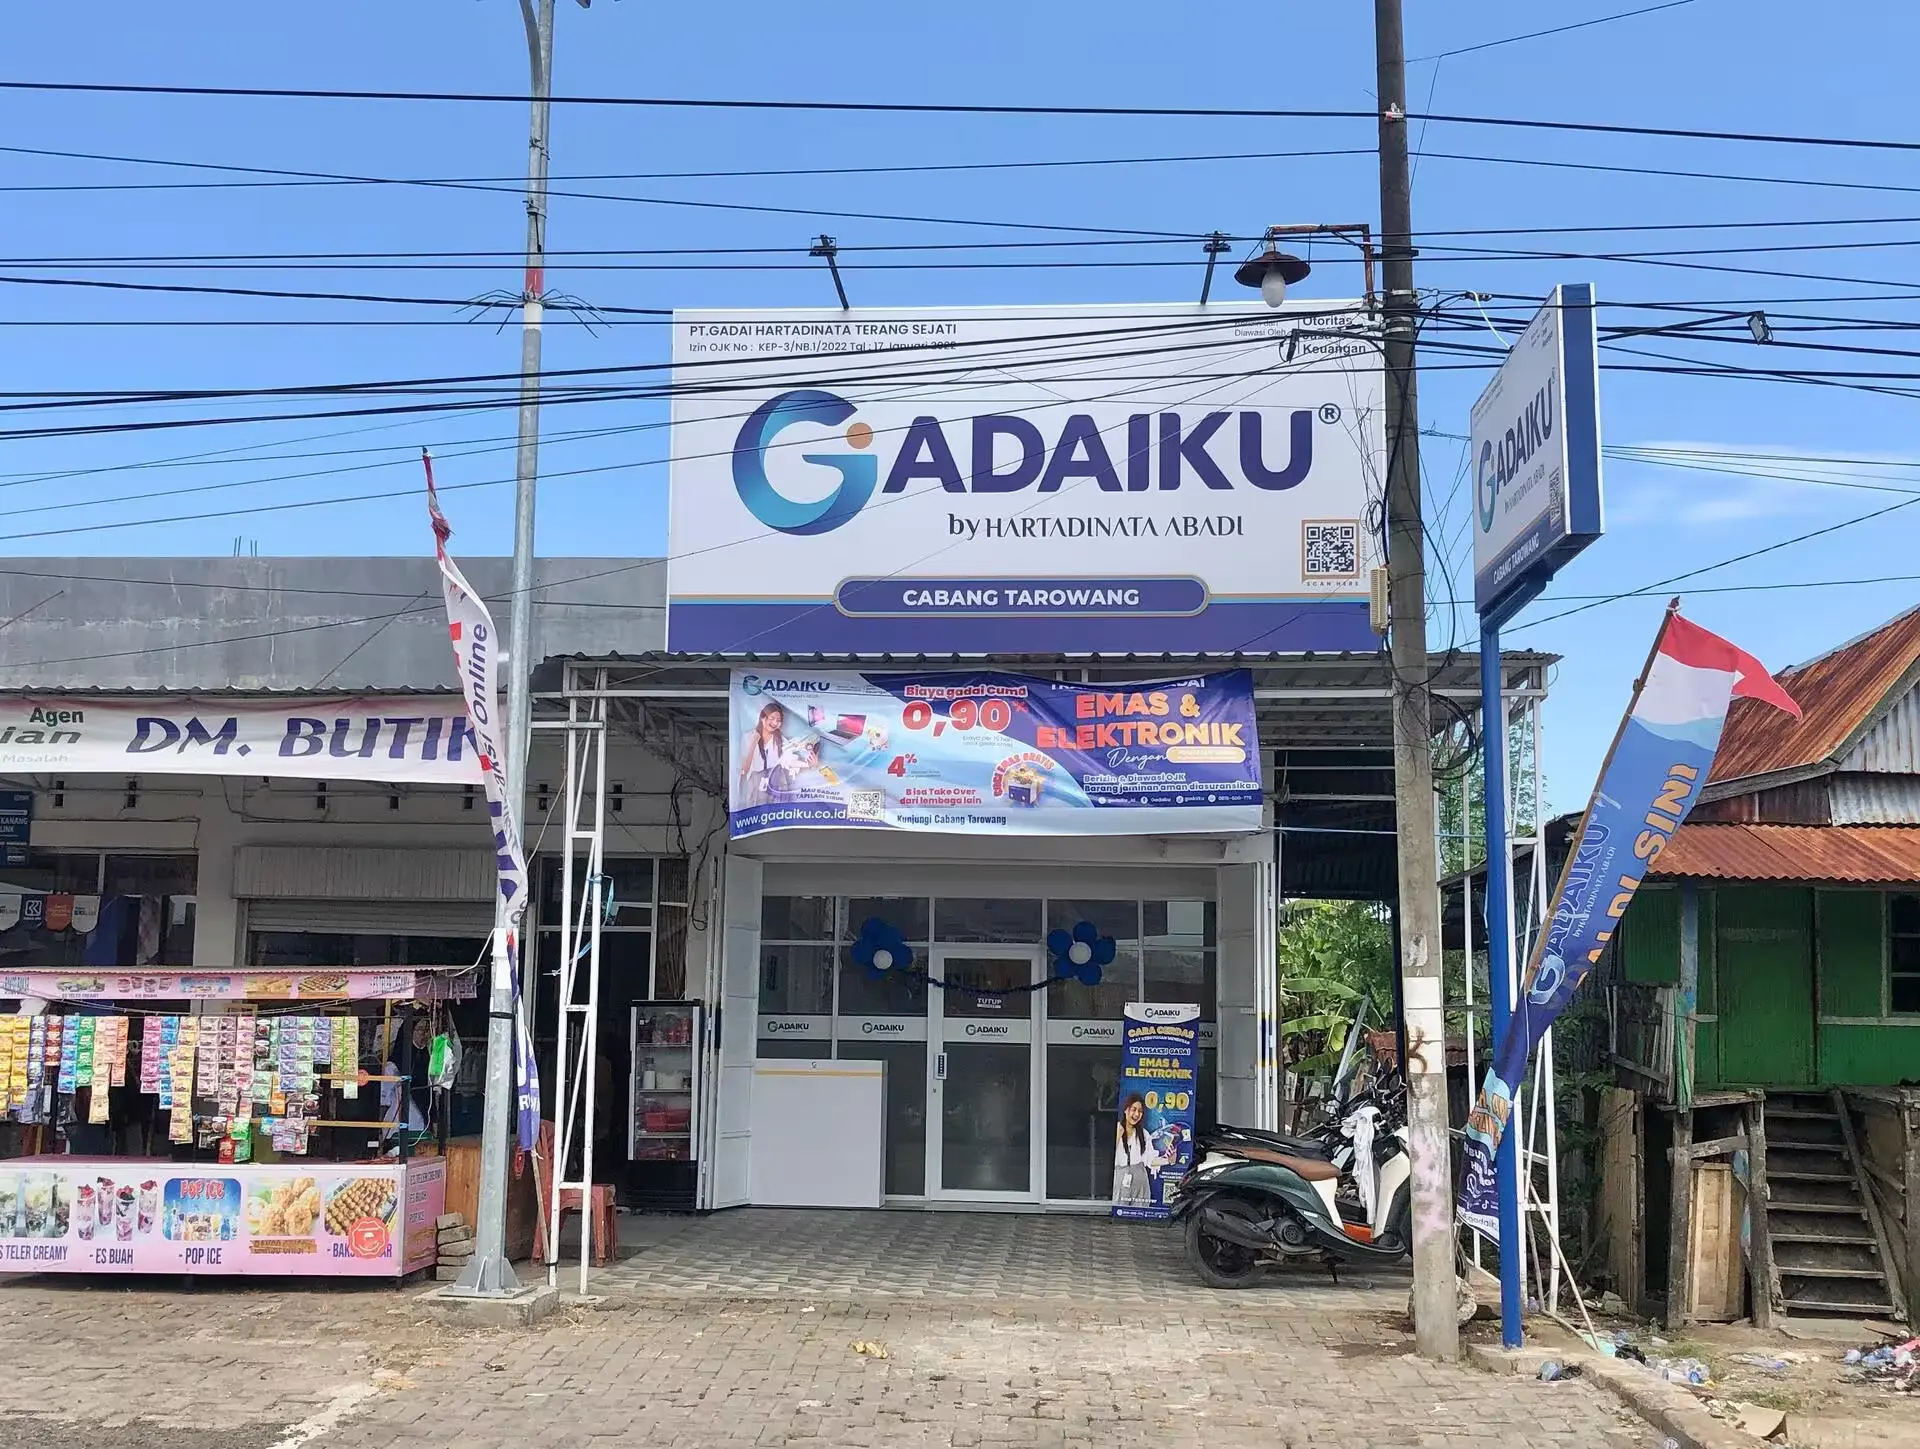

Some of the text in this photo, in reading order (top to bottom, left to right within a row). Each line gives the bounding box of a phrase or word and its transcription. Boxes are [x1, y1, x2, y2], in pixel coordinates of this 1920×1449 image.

[690, 324, 957, 336] PT.GADAI HARTADINATA TERANG SEJATI
[689, 343, 707, 352] Izin
[709, 343, 731, 352] OJK
[758, 342, 847, 352] KEP-3/NB.1/2022
[1303, 344, 1366, 356] Keuangan
[948, 513, 1244, 541] by HARTADINATA ABADI
[903, 587, 1140, 607] CABANG TAROWANG
[468, 623, 488, 725] Online
[742, 675, 831, 696] GADAIKU
[906, 686, 1026, 699] Biaya gadai Cuma
[1076, 692, 1201, 718] EMAS &
[29, 707, 84, 727] Agen
[126, 717, 254, 757] DM.
[1036, 722, 1246, 751] ELEKTRONIK
[1107, 748, 1168, 770] Dengan
[1128, 774, 1164, 782] Diawasi
[1166, 773, 1186, 781] OJK
[906, 788, 976, 796] Bisa Take Over
[1084, 781, 1258, 793] Barang jaminan aman diasuransikan
[900, 796, 982, 806] dari lembaga lain
[736, 808, 846, 829] www.gadaiku.co.id
[897, 814, 1007, 826] Kunjungi Cabang Tarowang
[1634, 763, 1700, 866] SINI
[1600, 846, 1616, 878] ABADI
[1139, 1057, 1169, 1068] EMAS
[1125, 1067, 1192, 1079] ELEKTRONIK
[181, 1180, 224, 1200] POP ICE
[6, 1246, 31, 1260] TELER
[33, 1246, 68, 1261] CREAMY
[96, 1249, 133, 1264] ES BUAH
[185, 1248, 222, 1264] POP ICE
